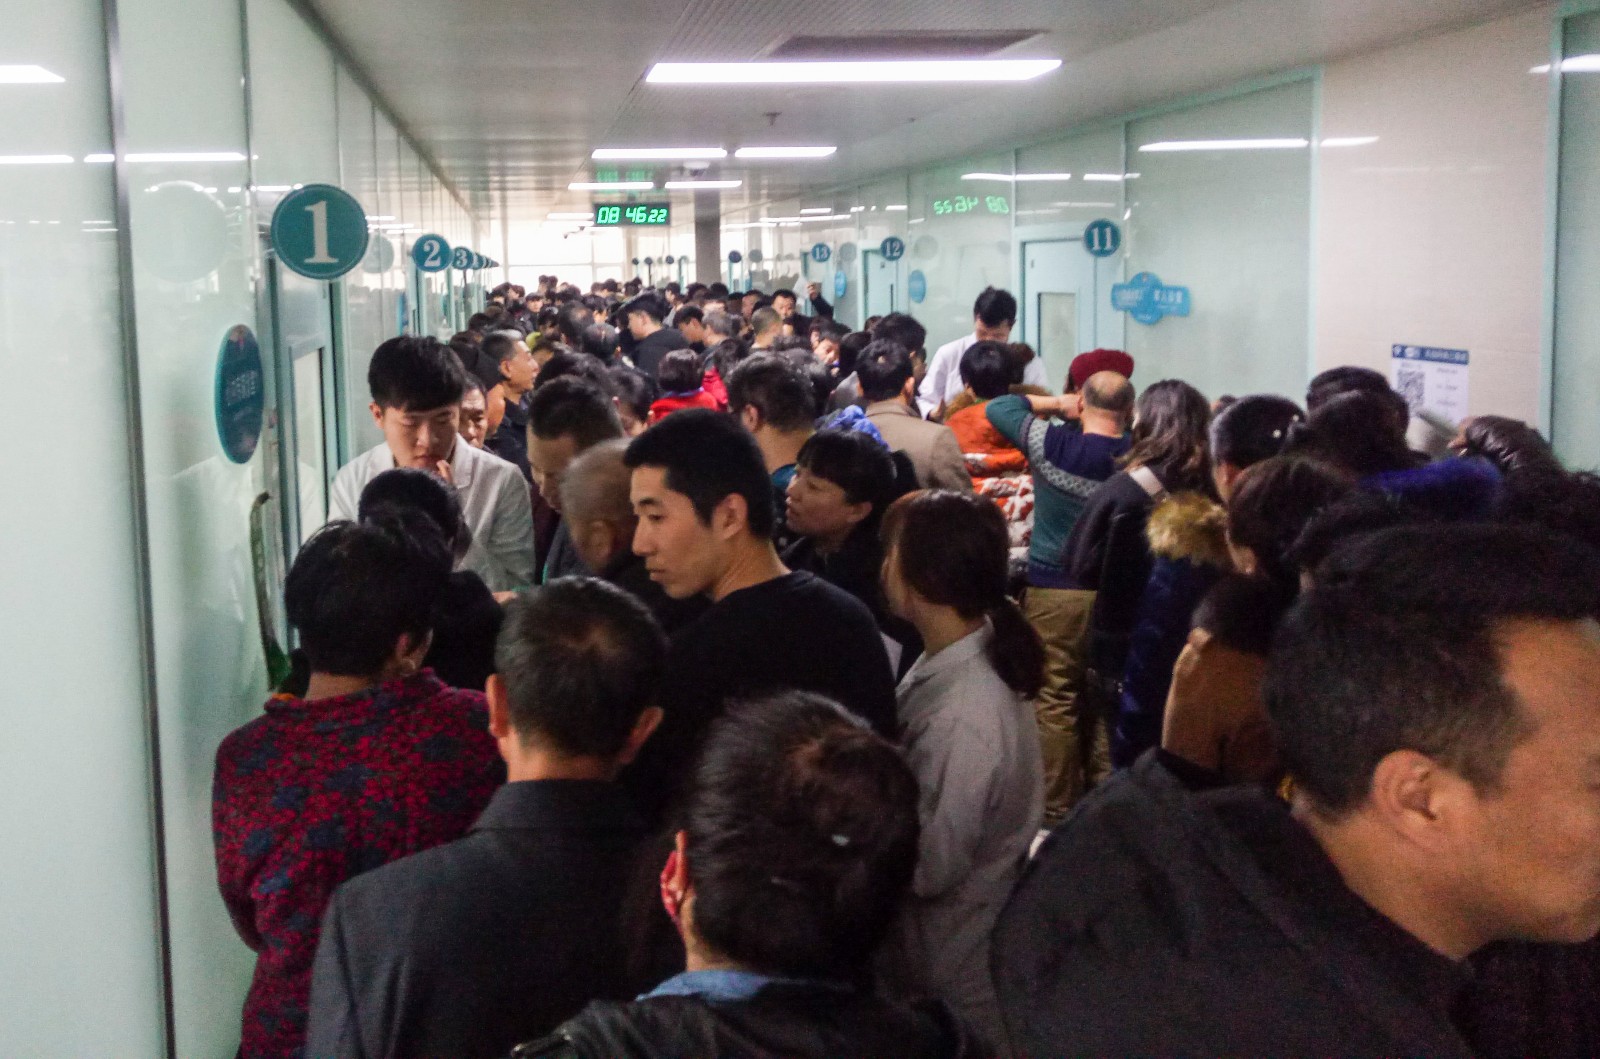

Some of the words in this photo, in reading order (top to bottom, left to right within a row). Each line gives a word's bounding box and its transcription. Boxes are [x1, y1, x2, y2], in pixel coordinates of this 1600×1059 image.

[597, 206, 620, 223] 08
[625, 206, 647, 223] 46
[648, 208, 668, 223] 22
[304, 200, 339, 264] 1
[1091, 227, 1114, 250] 11
[423, 239, 441, 267] 2
[455, 249, 467, 268] 3
[885, 241, 900, 257] 12
